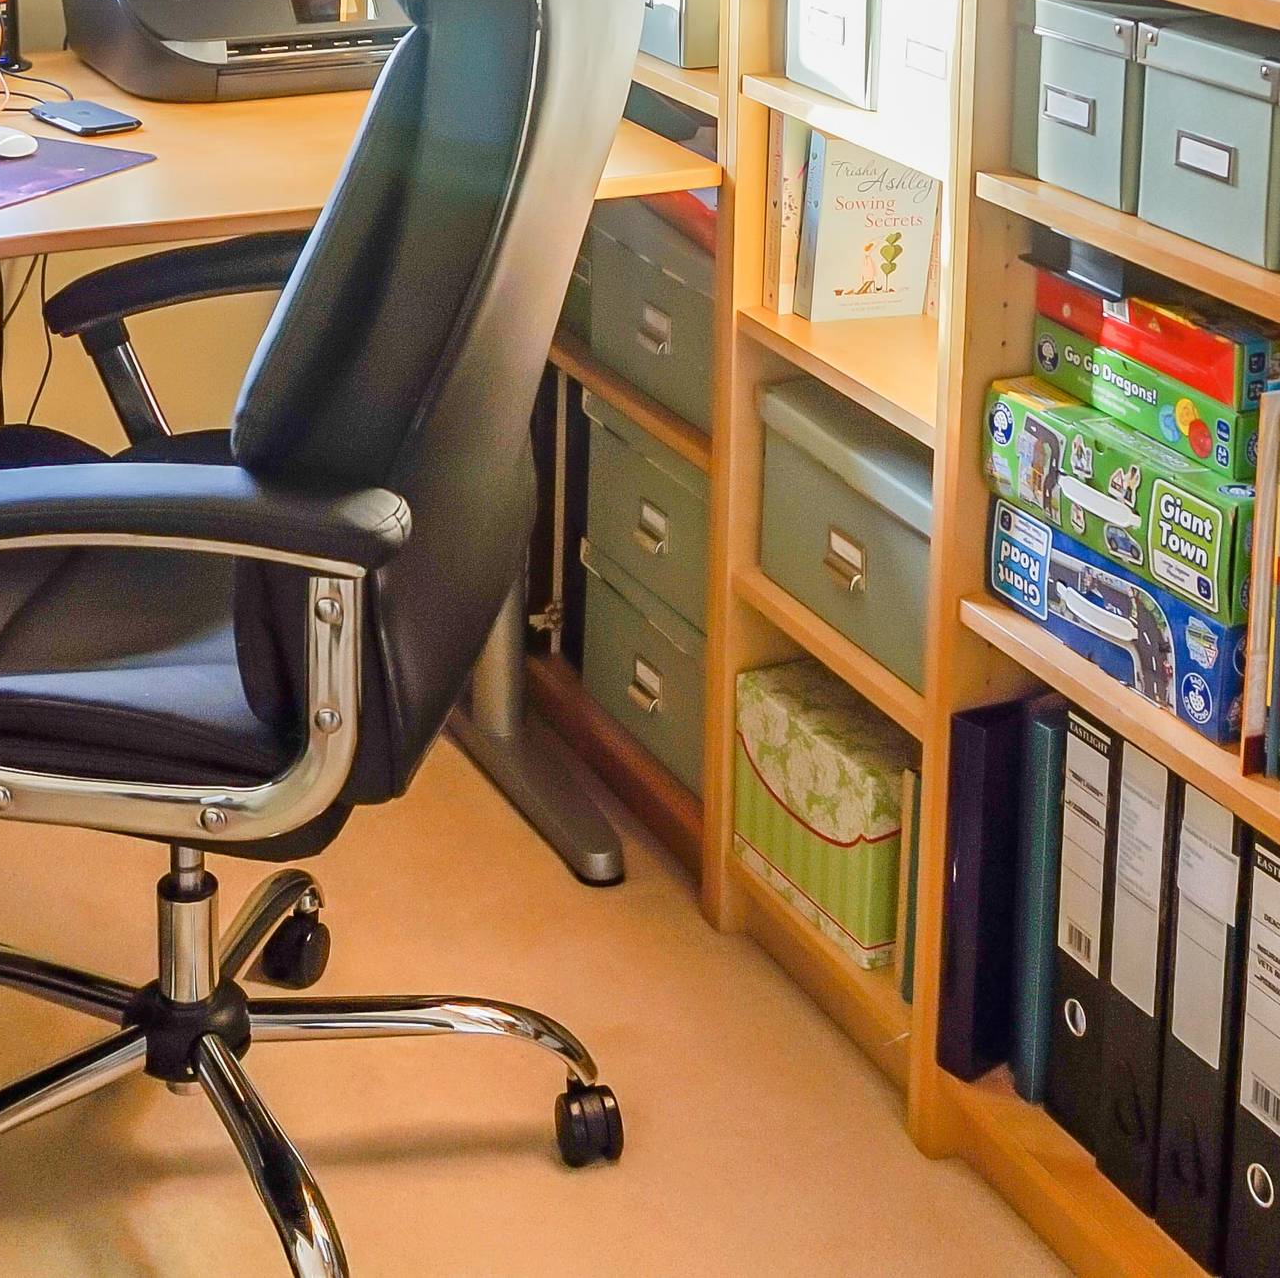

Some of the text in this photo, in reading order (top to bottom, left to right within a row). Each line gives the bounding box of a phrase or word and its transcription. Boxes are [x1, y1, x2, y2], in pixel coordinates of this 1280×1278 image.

[834, 196, 897, 216] Sowing
[857, 168, 934, 204] Ashley
[864, 214, 923, 228] Secrets
[1064, 346, 1158, 406] Go Go Dragons!
[1159, 493, 1212, 541] Giant
[1000, 540, 1040, 582] Road
[1158, 520, 1208, 568] Town
[998, 562, 1041, 606] Giant
[1070, 722, 1108, 754] EASTLIGHT
